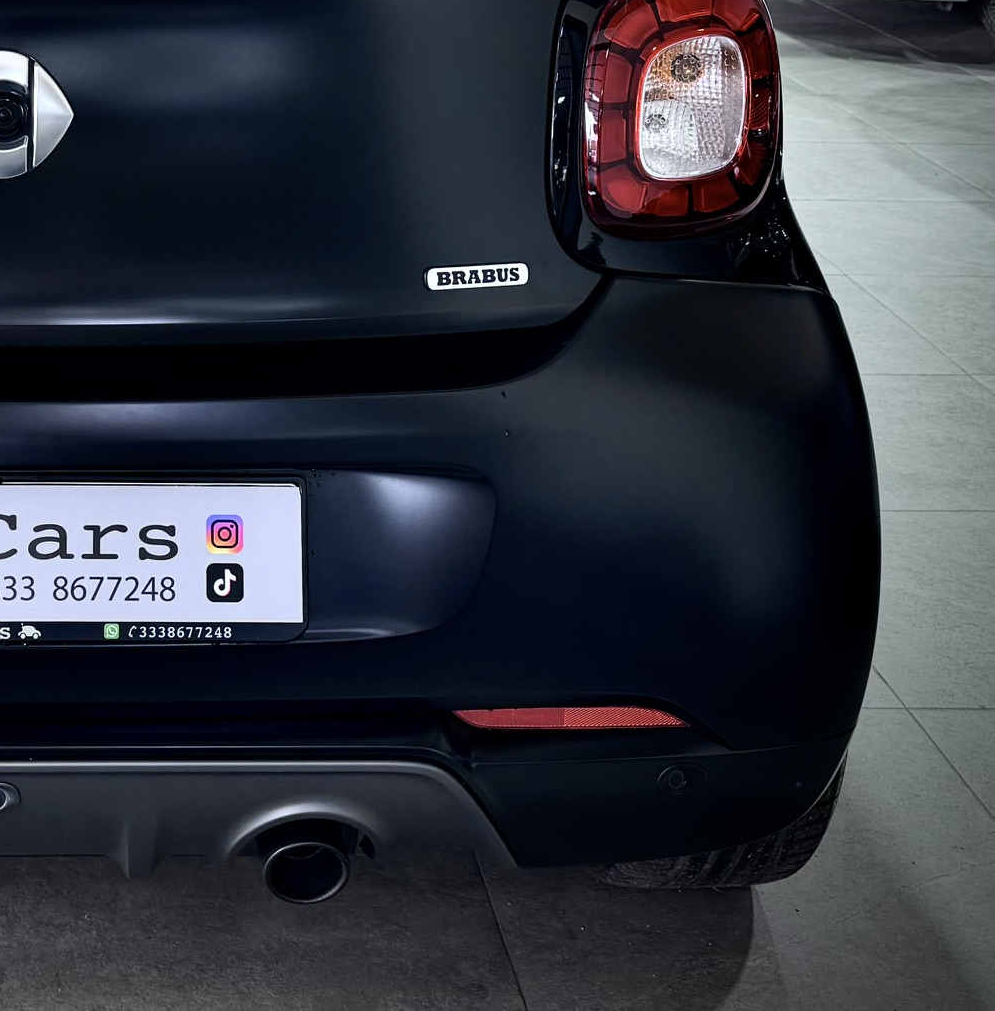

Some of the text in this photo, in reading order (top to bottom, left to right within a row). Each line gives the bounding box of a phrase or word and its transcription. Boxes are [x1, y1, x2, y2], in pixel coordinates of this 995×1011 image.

[436, 267, 520, 286] BRABUS
[52, 576, 176, 602] 8677248
[139, 626, 232, 639] 3338677248
